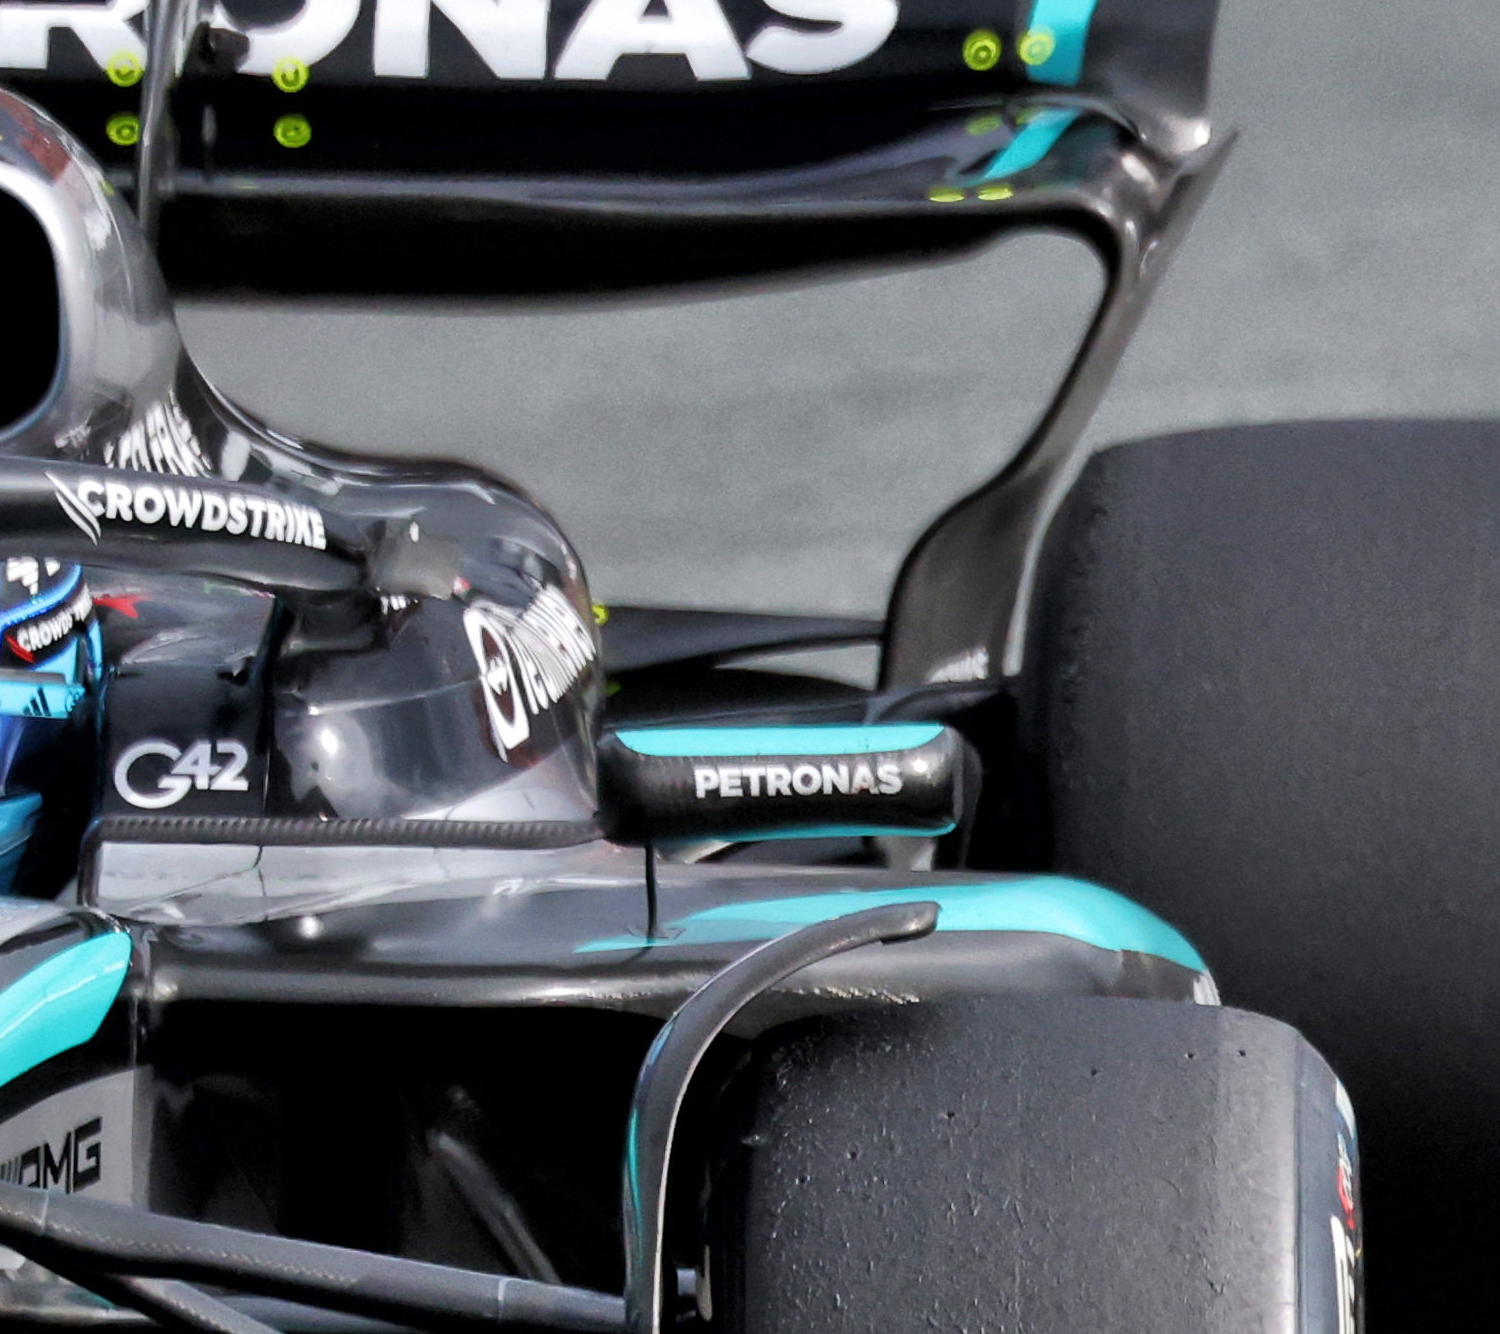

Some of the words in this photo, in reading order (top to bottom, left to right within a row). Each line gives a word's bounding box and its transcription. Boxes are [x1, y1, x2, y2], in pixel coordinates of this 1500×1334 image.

[77, 480, 326, 550] CROWDSTRIKE
[113, 739, 249, 808] G42
[695, 762, 902, 798] PETRONAS
